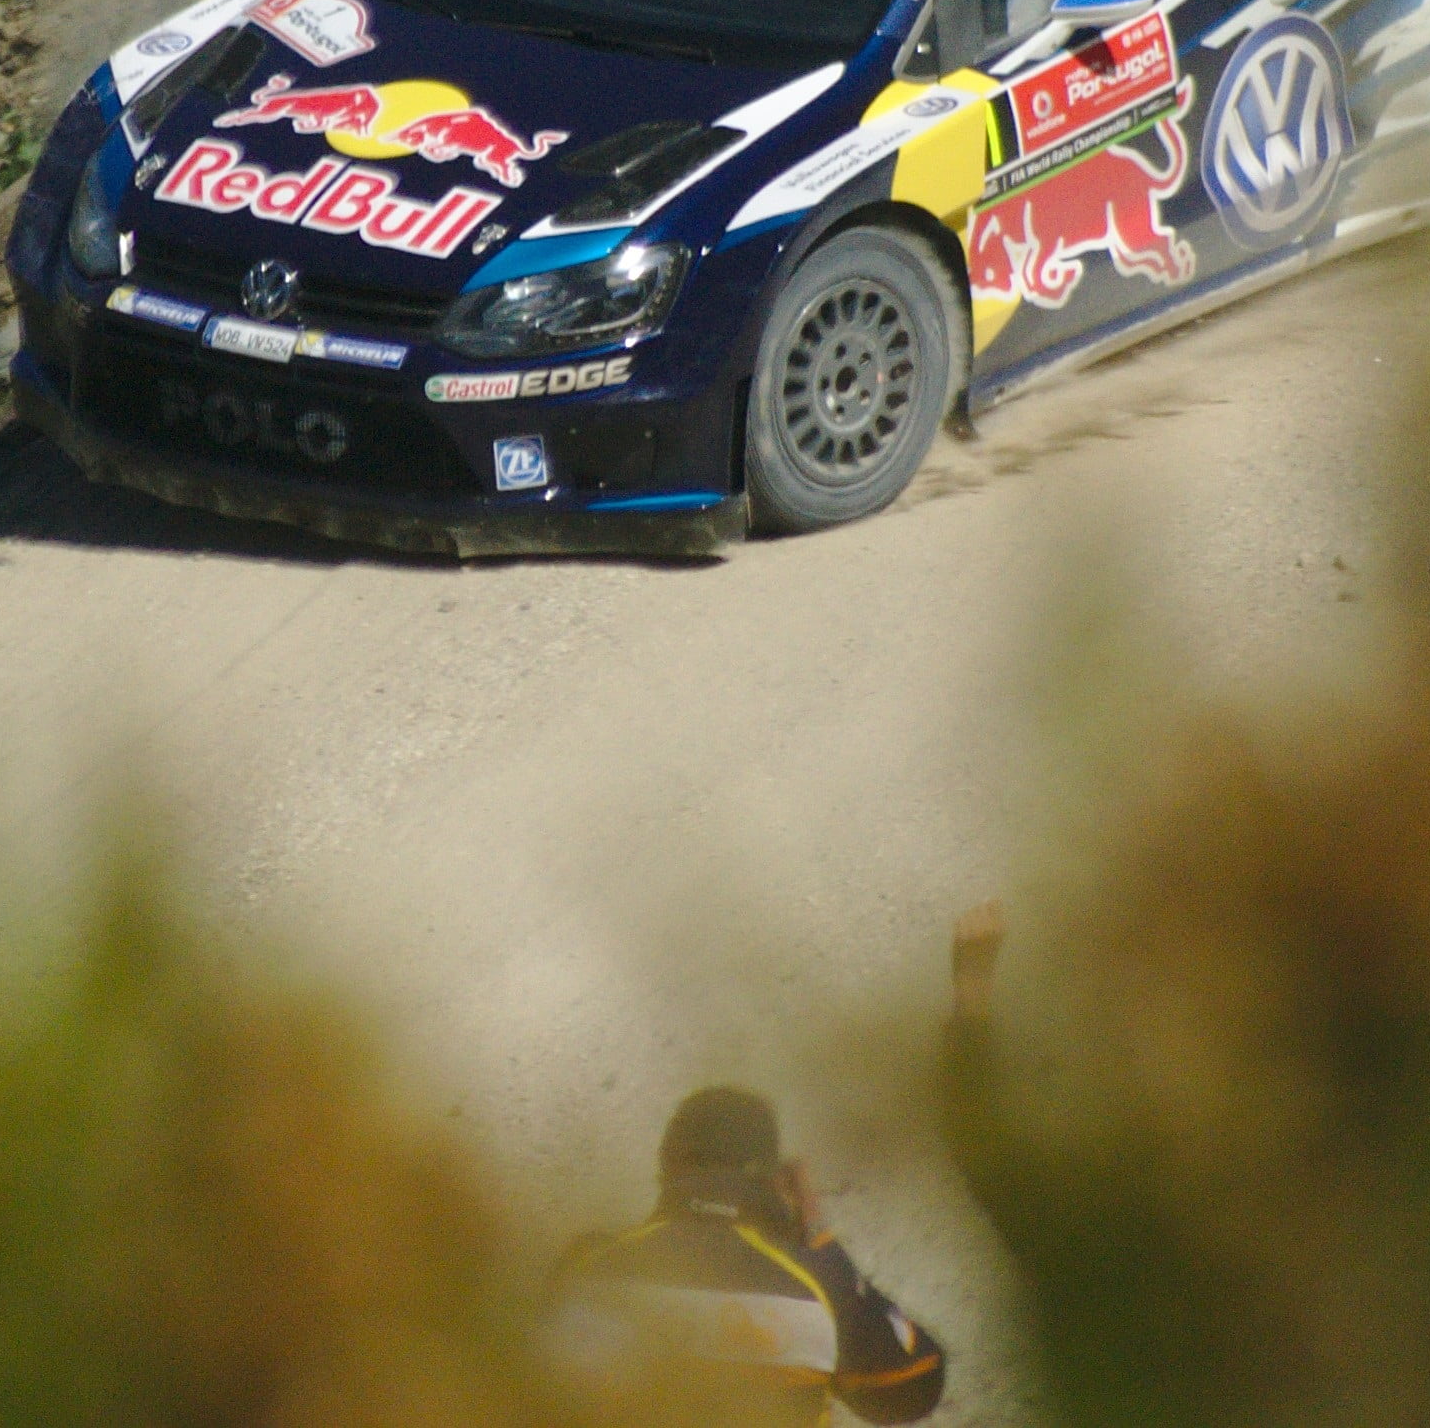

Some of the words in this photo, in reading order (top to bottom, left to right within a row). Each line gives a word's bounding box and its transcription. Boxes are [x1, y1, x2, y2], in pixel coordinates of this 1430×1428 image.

[1067, 39, 1165, 107] Portugal
[1026, 155, 1051, 177] World
[1051, 144, 1073, 167] Rally
[1073, 117, 1131, 154] Championship
[158, 141, 341, 220] Red
[306, 170, 497, 256] Bull
[445, 376, 515, 401] Castrol
[520, 356, 634, 398] EDGE
[506, 448, 539, 478] ZF
